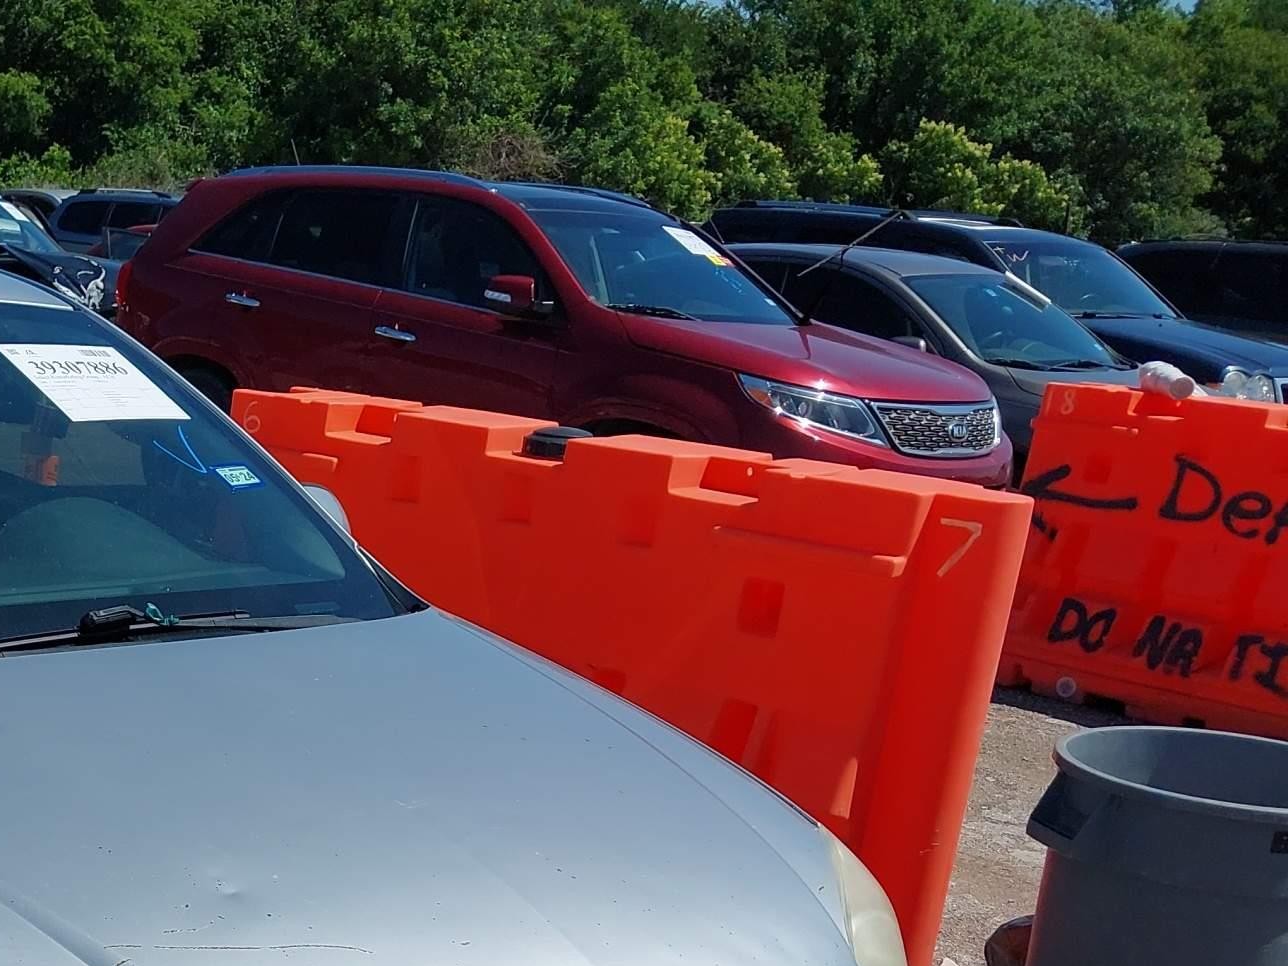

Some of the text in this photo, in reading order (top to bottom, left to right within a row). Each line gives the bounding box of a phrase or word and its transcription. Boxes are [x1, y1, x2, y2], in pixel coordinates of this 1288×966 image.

[28, 361, 128, 375] 39307886
[243, 400, 261, 433] 6
[952, 424, 968, 438] KIA
[937, 517, 983, 577] 7
[1047, 597, 1117, 653] DO
